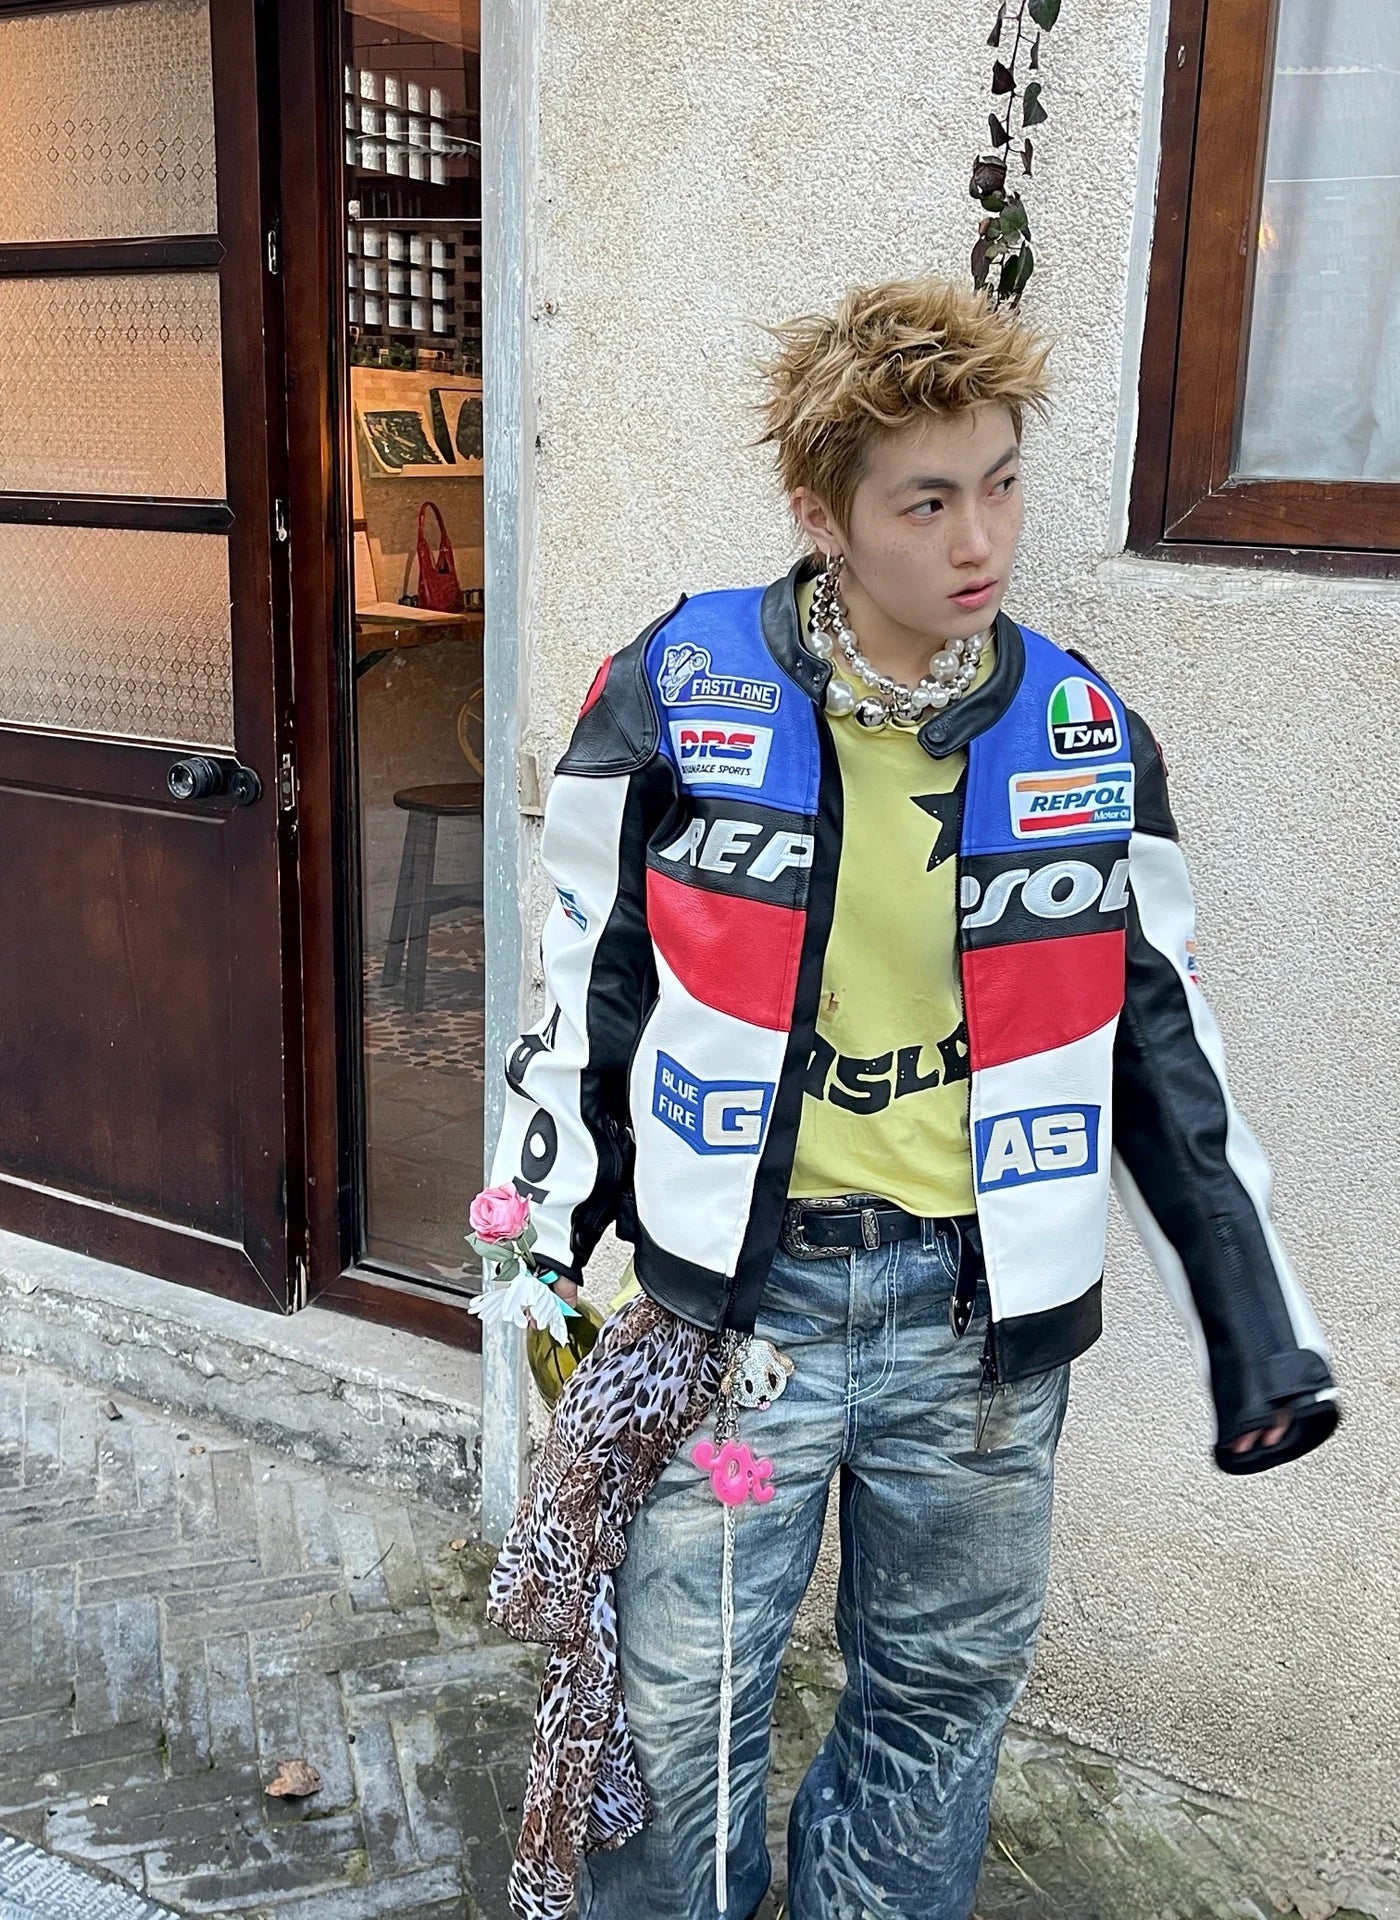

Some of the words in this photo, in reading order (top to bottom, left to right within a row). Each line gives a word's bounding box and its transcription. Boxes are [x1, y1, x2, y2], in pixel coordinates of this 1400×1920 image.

[691, 678, 775, 703] FASTLANE
[717, 764, 752, 776] SPORTS
[1029, 786, 1126, 813] REPSOL
[1094, 810, 1119, 821] Motor
[657, 817, 815, 882] REP
[661, 1067, 699, 1105] BLUE
[702, 1088, 766, 1147] G
[980, 1112, 1089, 1184] AS
